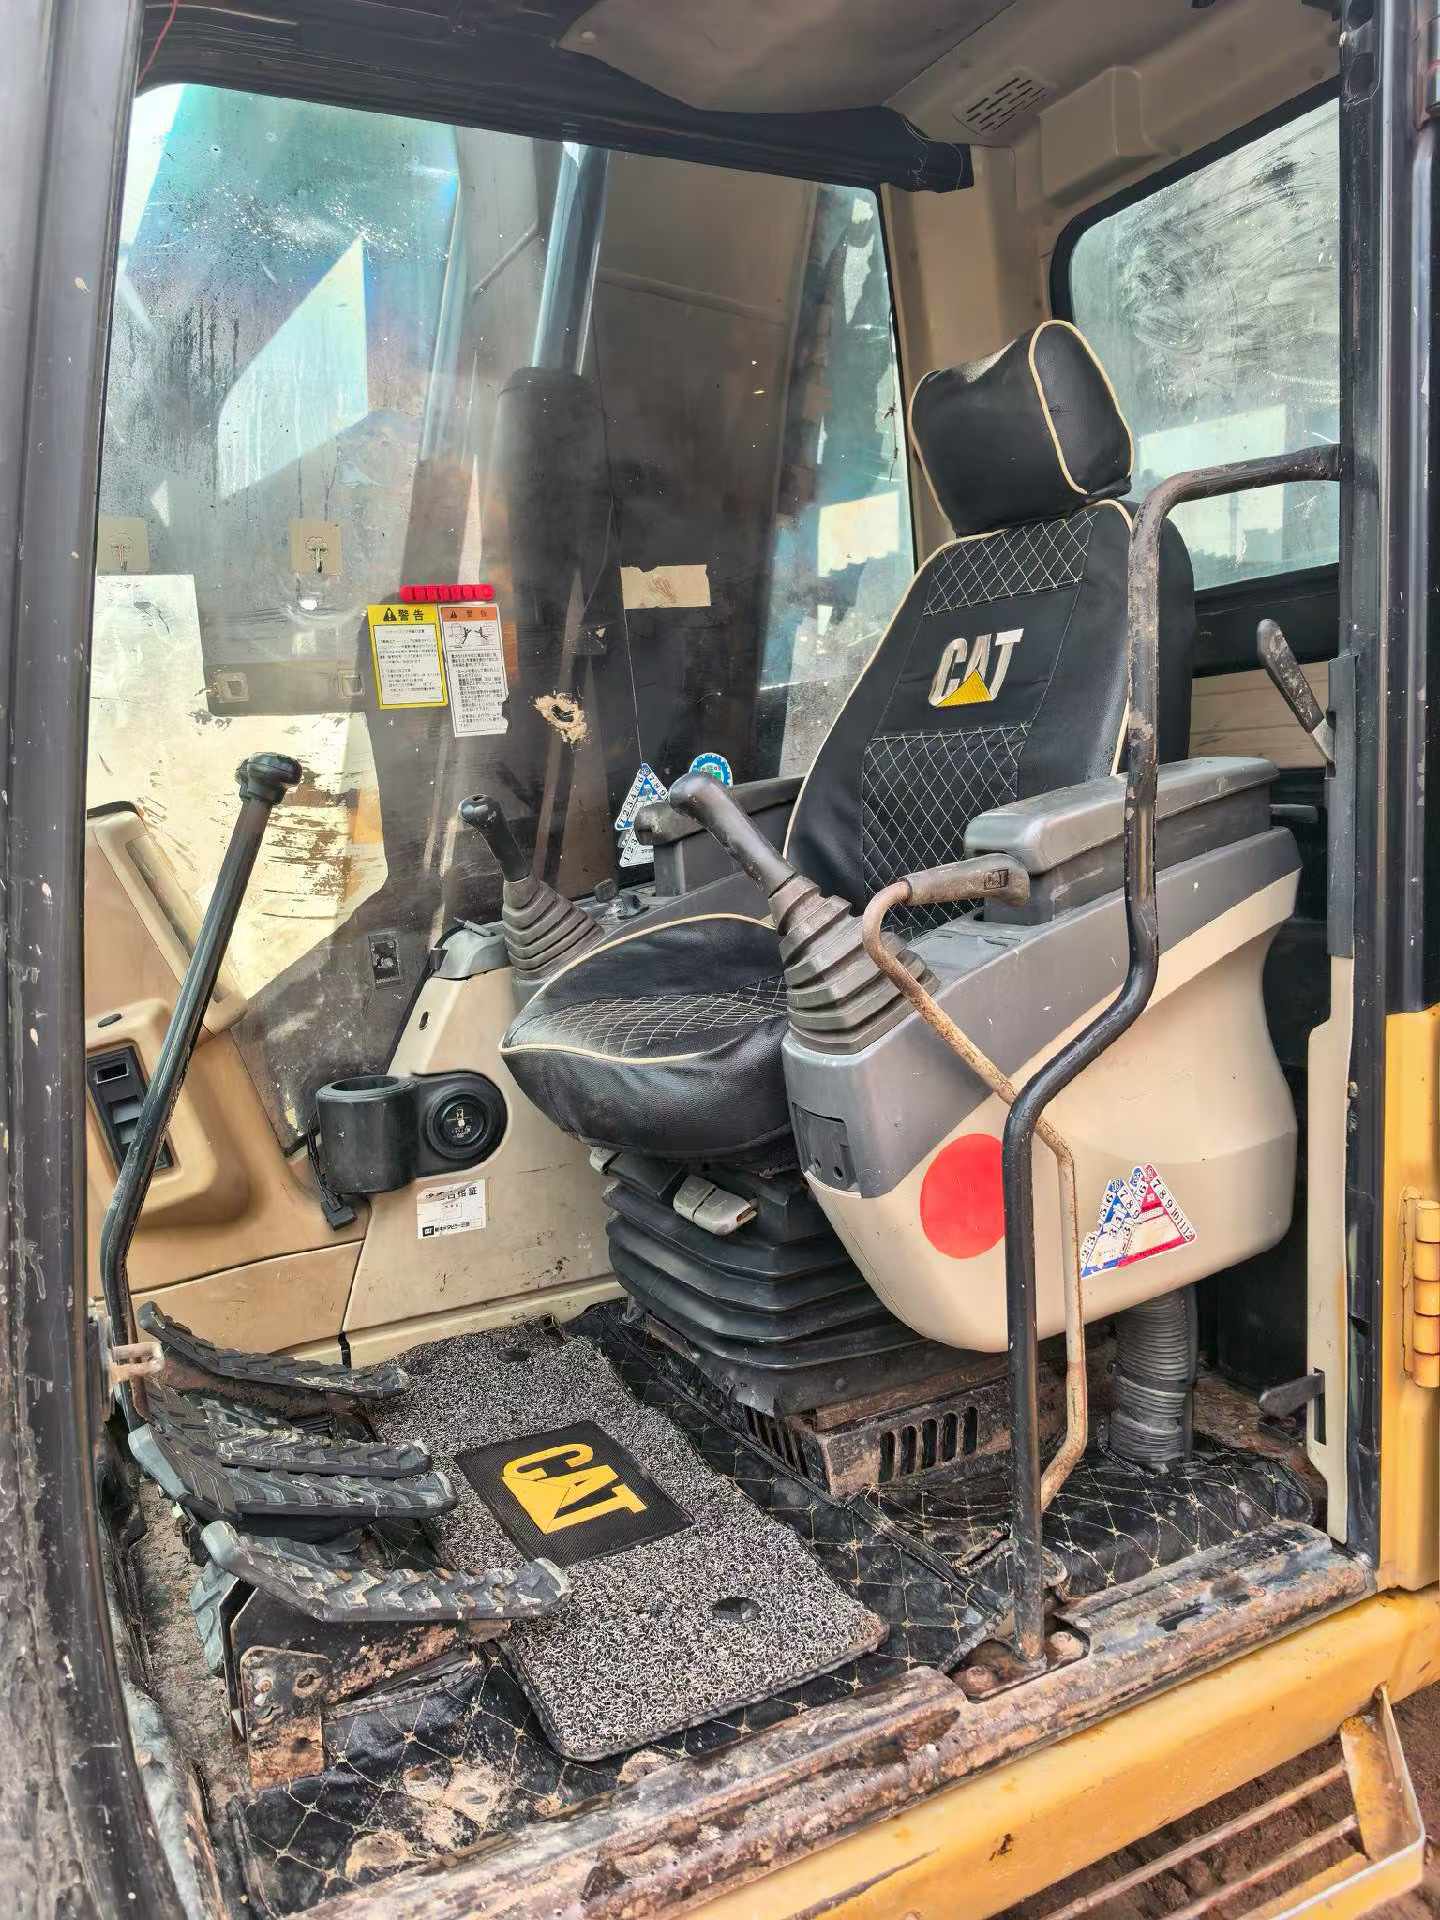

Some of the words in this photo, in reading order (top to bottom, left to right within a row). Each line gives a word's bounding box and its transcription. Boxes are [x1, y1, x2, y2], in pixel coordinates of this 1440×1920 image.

[398, 608, 424, 622] 警告
[928, 628, 1025, 707] CAT
[501, 1443, 647, 1534] CAT
